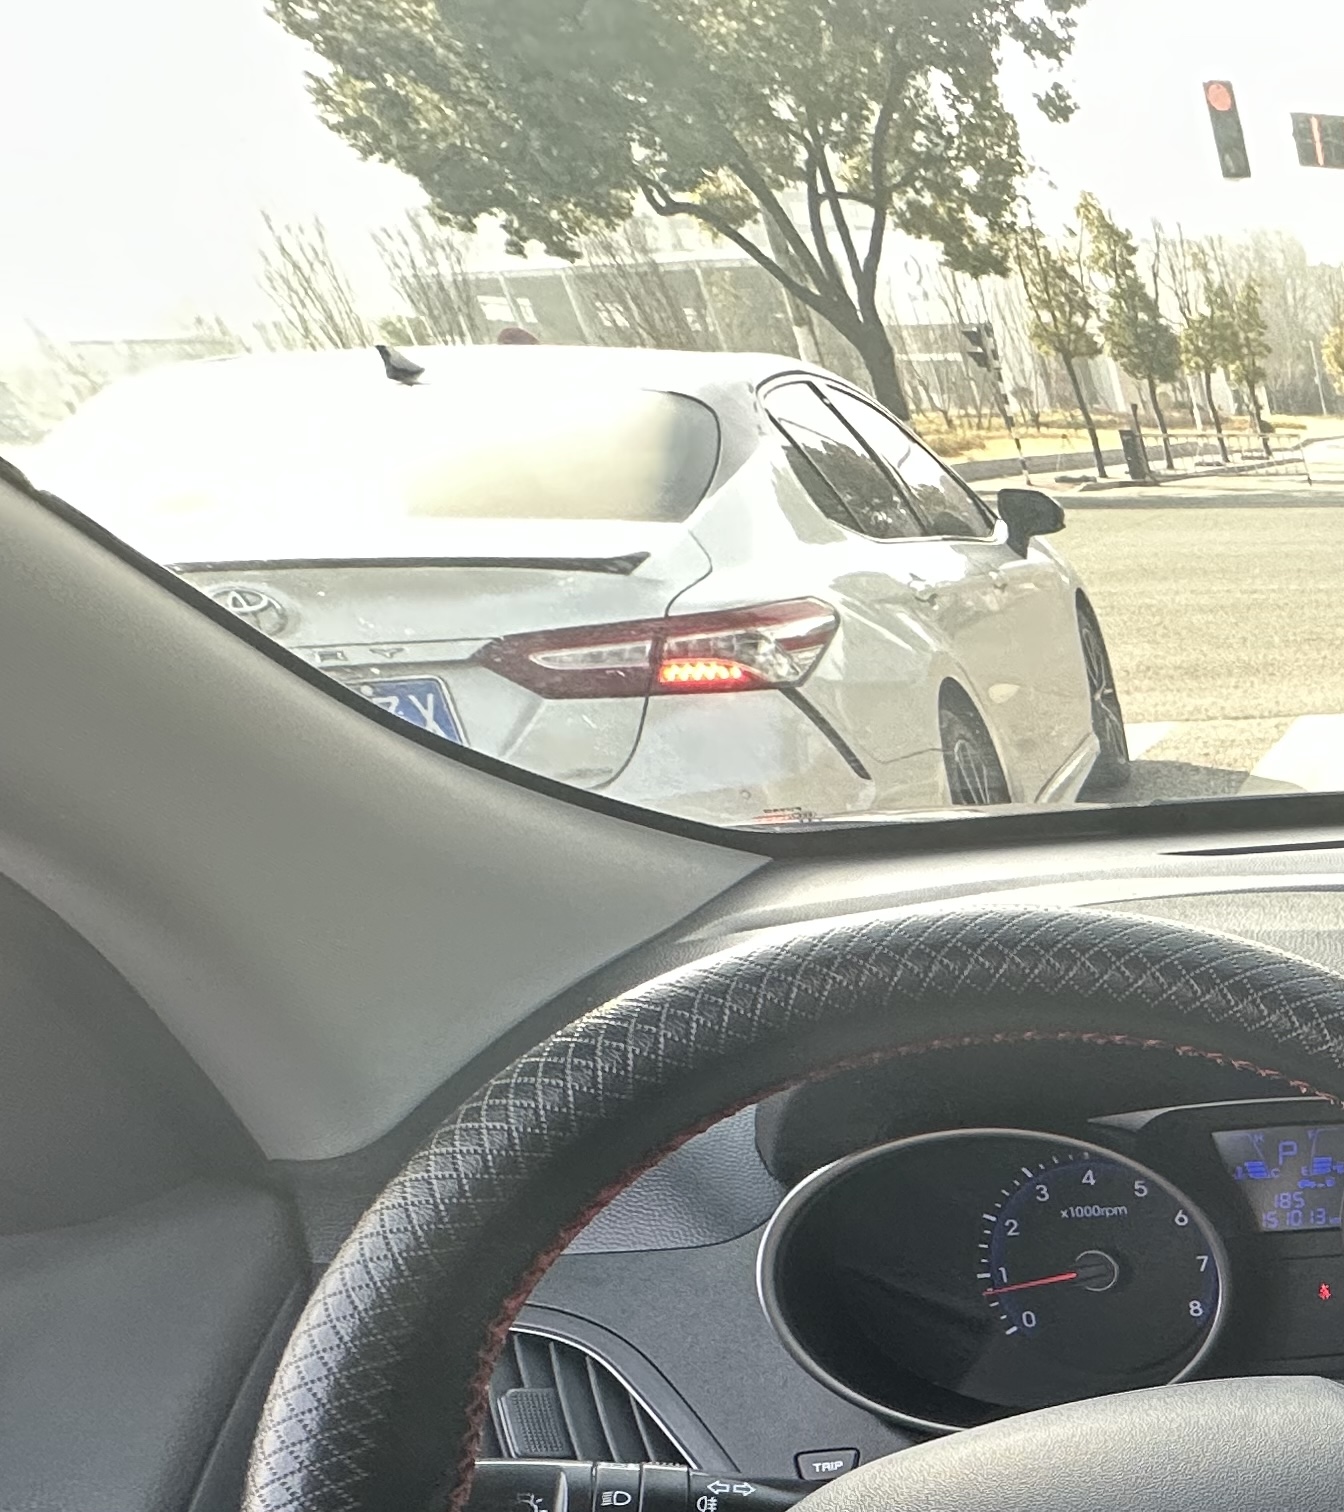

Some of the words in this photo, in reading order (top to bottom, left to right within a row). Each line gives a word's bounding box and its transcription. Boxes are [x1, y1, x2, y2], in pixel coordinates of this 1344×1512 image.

[1082, 1169, 1096, 1186] 4
[1036, 1184, 1050, 1202] 3
[1134, 1181, 1148, 1198] 5
[1060, 1204, 1128, 1220] x1000rpm
[1174, 1209, 1189, 1226] 6
[1004, 1219, 1020, 1236] 2
[1196, 1255, 1208, 1272] 7
[998, 1267, 1009, 1283] 1
[1189, 1300, 1203, 1317] 8
[1022, 1311, 1036, 1327] 0
[812, 1460, 844, 1472] TRIP
